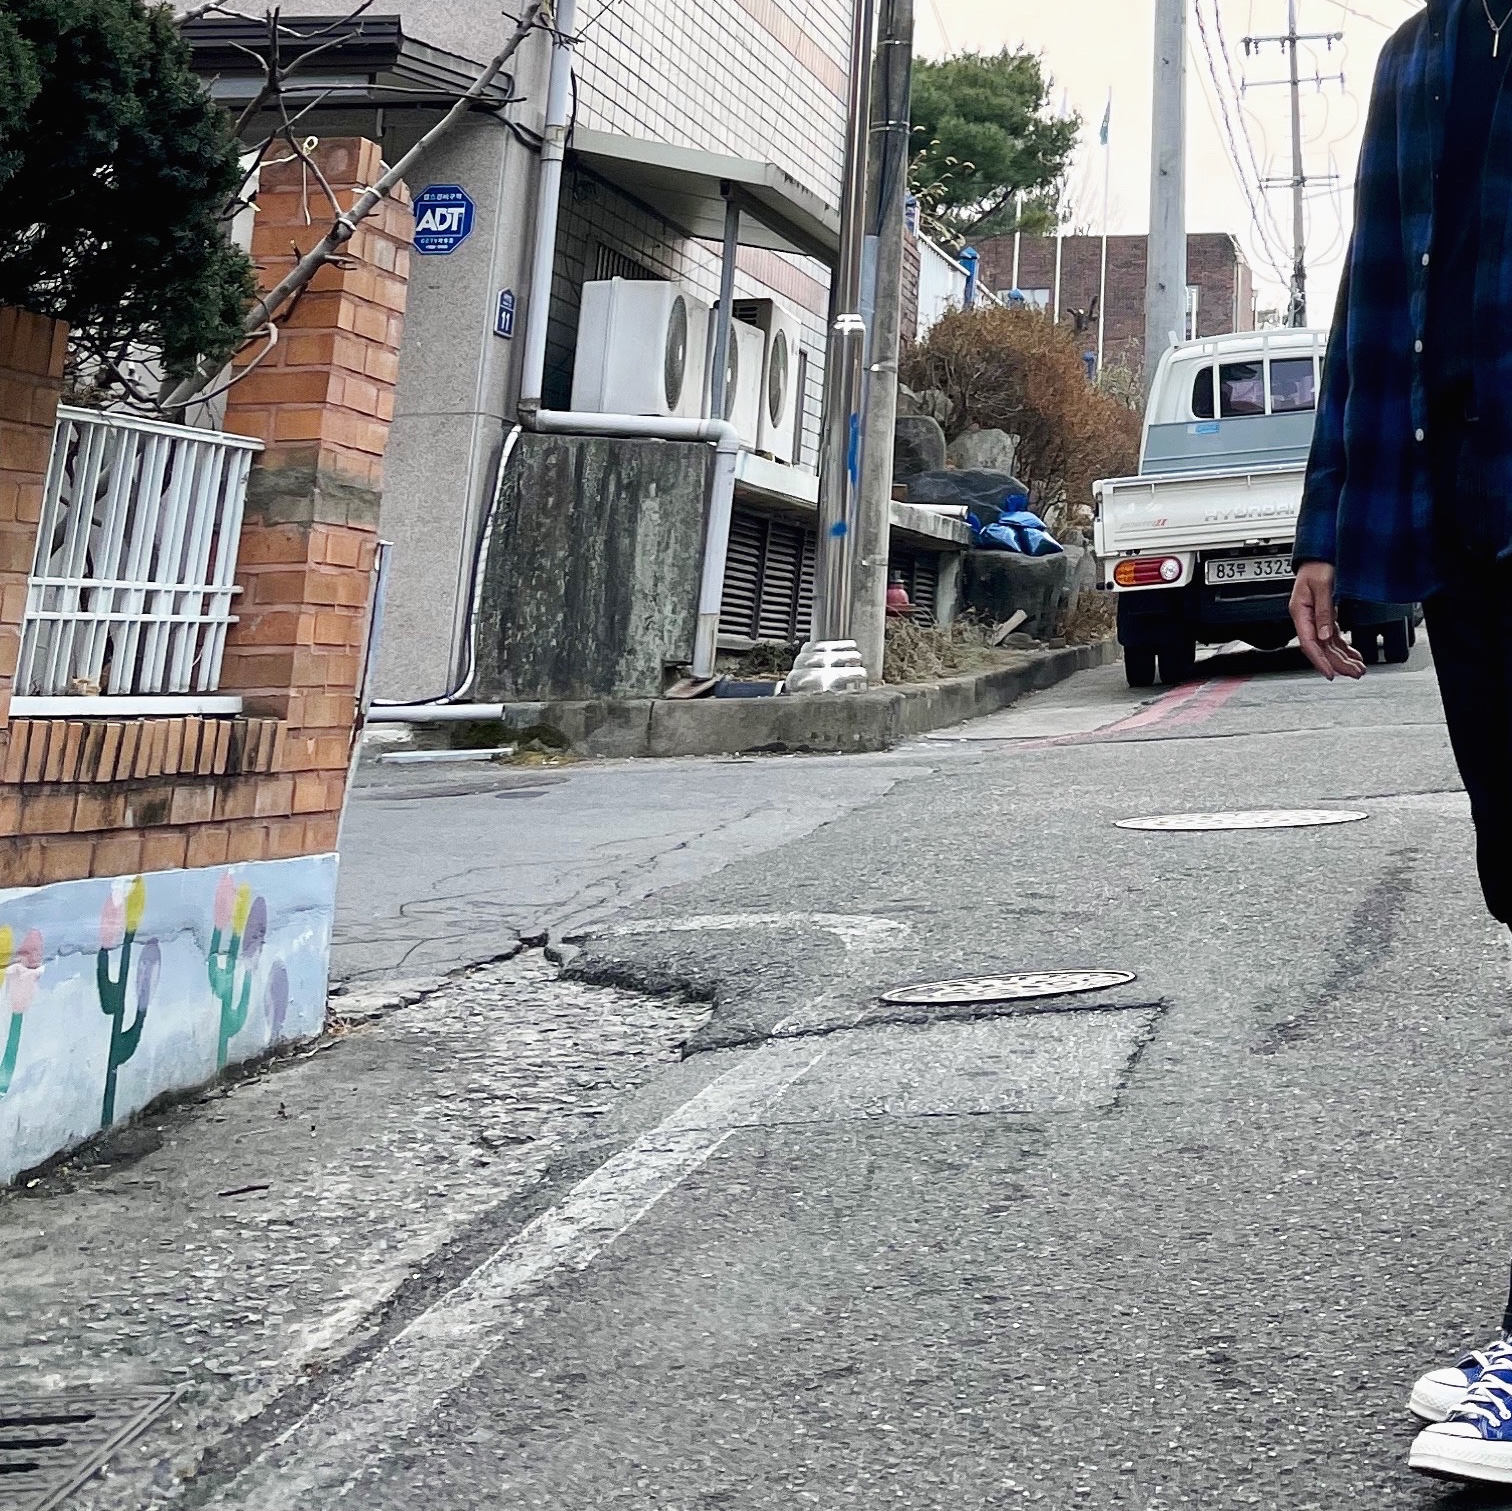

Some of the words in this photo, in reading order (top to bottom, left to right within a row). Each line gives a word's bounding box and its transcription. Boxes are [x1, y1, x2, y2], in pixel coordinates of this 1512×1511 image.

[416, 208, 465, 231] ADT
[501, 311, 511, 331] 11
[1204, 504, 1295, 522] HYUNDAI
